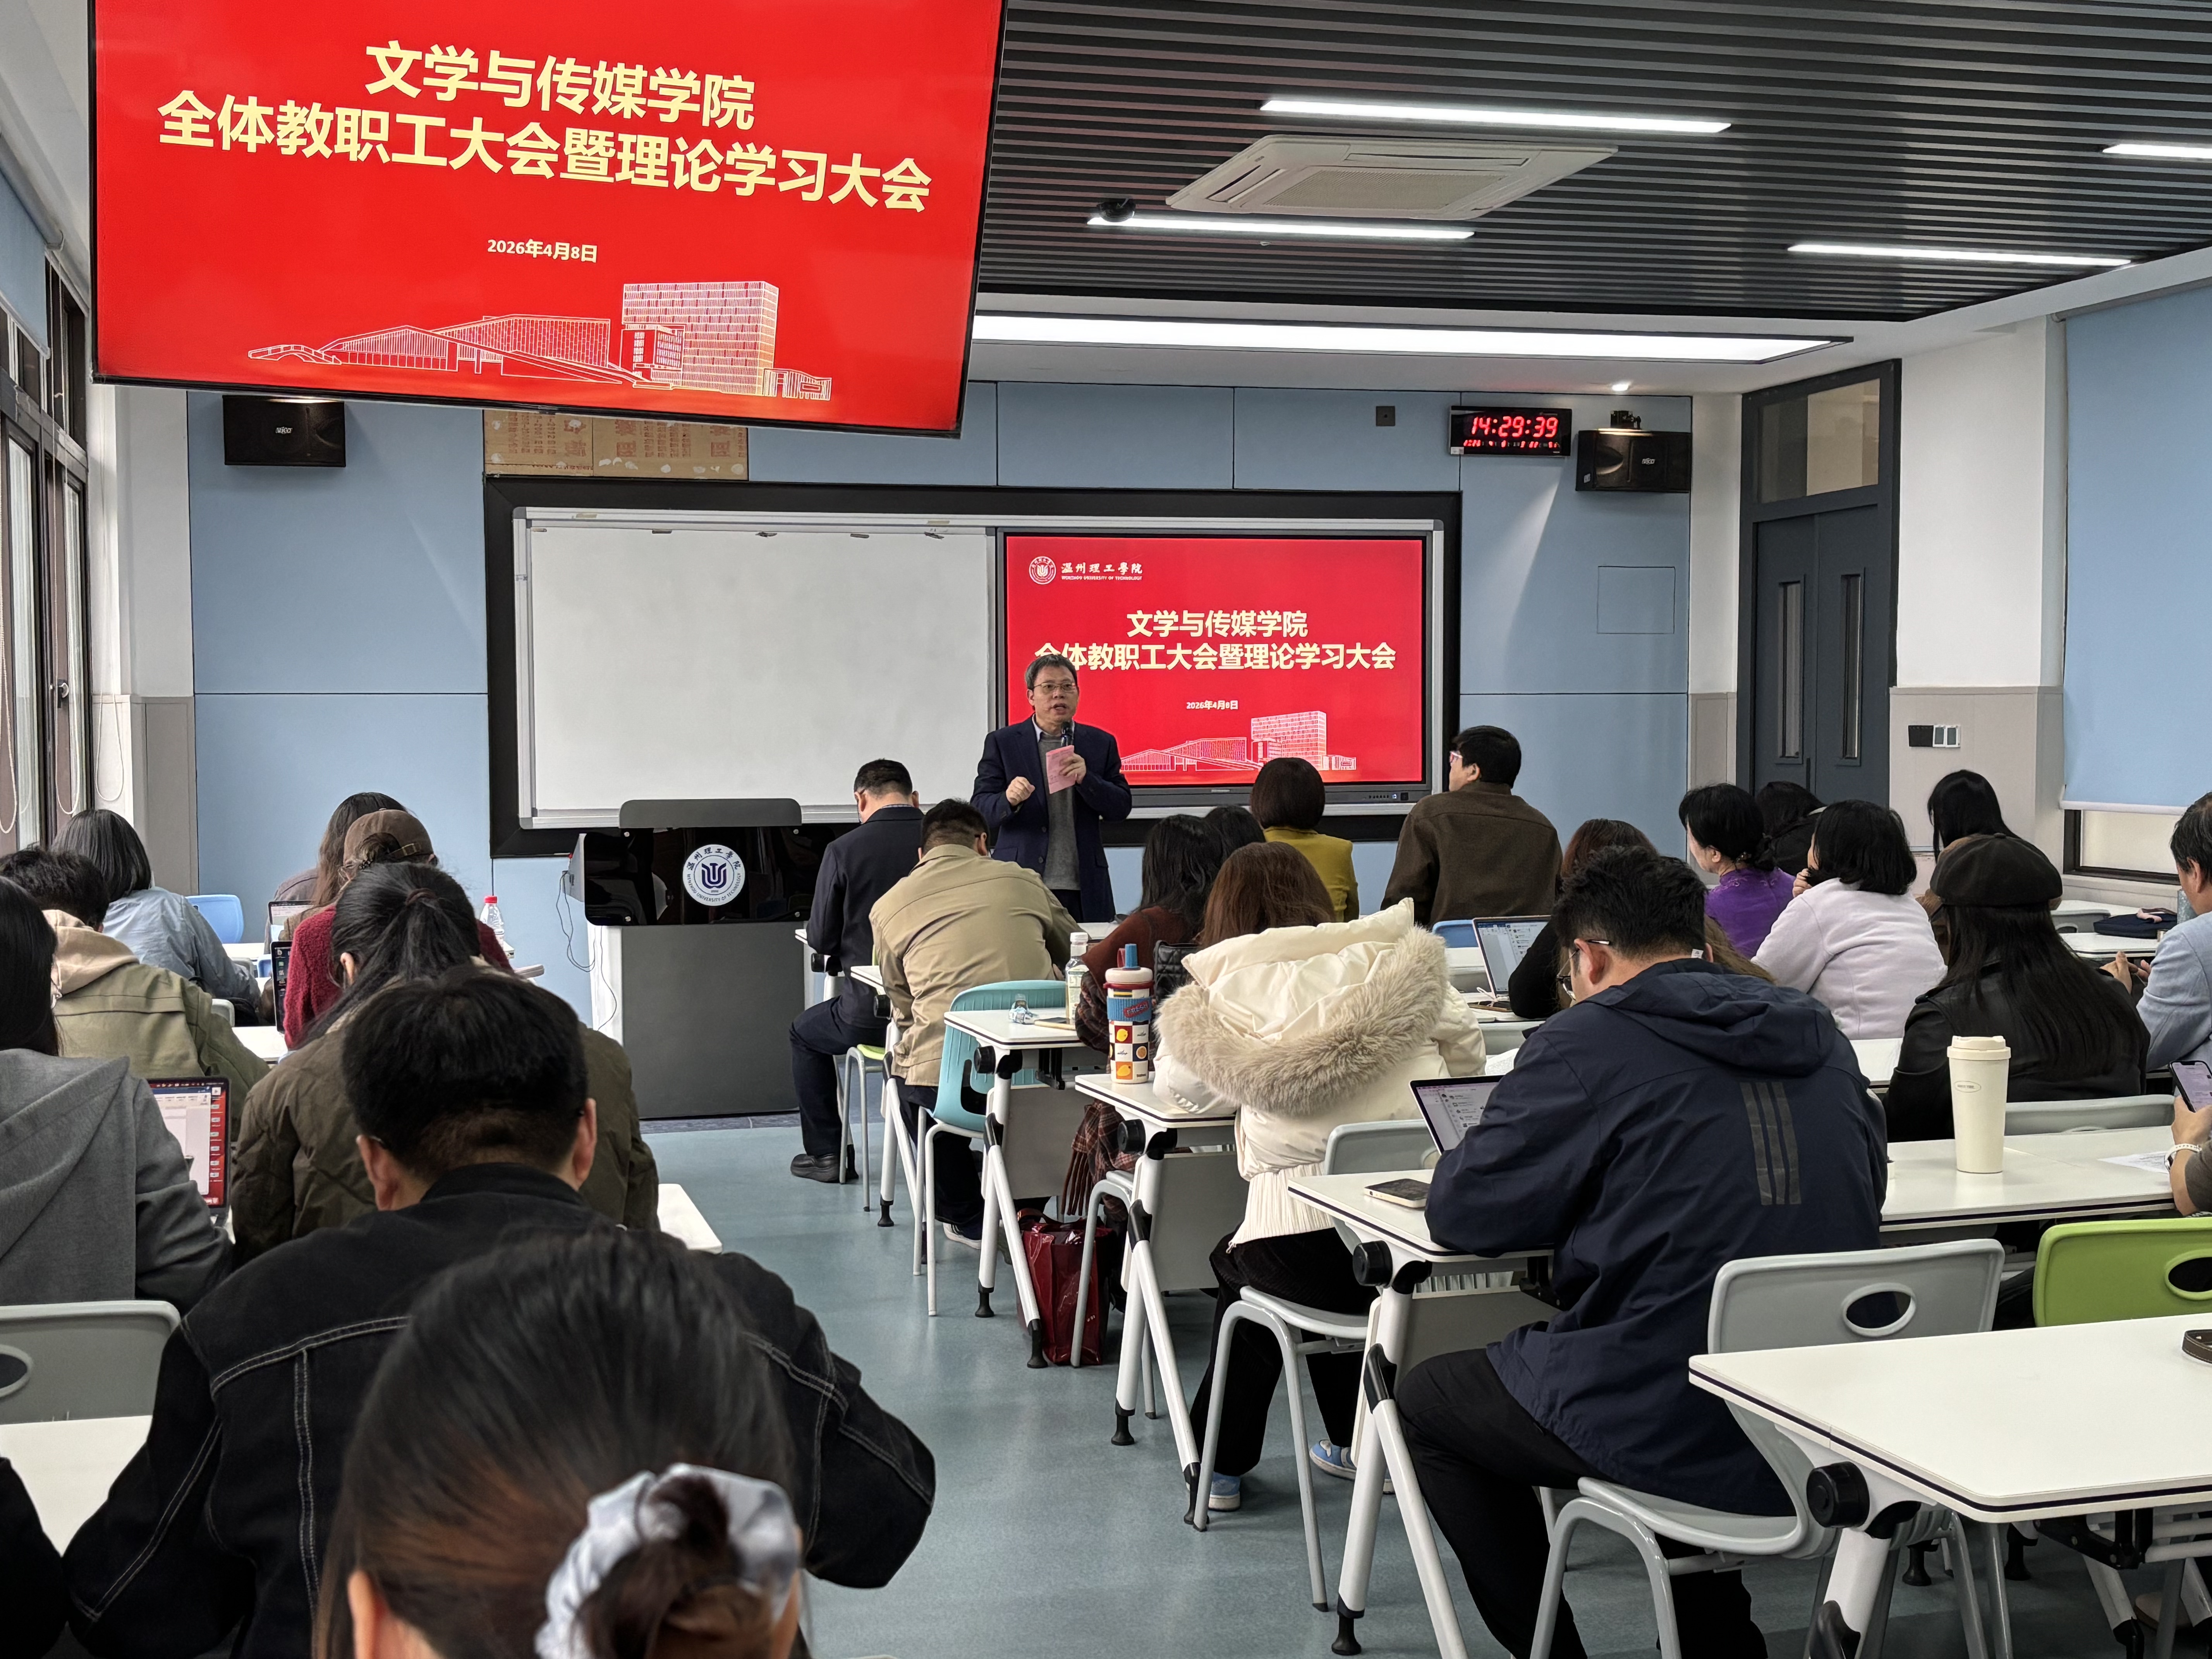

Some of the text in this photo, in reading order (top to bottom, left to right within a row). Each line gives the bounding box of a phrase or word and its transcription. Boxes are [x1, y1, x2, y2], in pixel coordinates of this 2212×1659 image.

[366, 40, 755, 130] 文学与传媒学院
[157, 90, 932, 213] 全体教职工大会暨理论学习大会
[488, 239, 598, 263] 2026年4月8日
[1471, 416, 1559, 437] 14:29:39
[1127, 610, 1309, 637] 文学与传媒学院
[1186, 699, 1238, 710] 2026年4月8日
